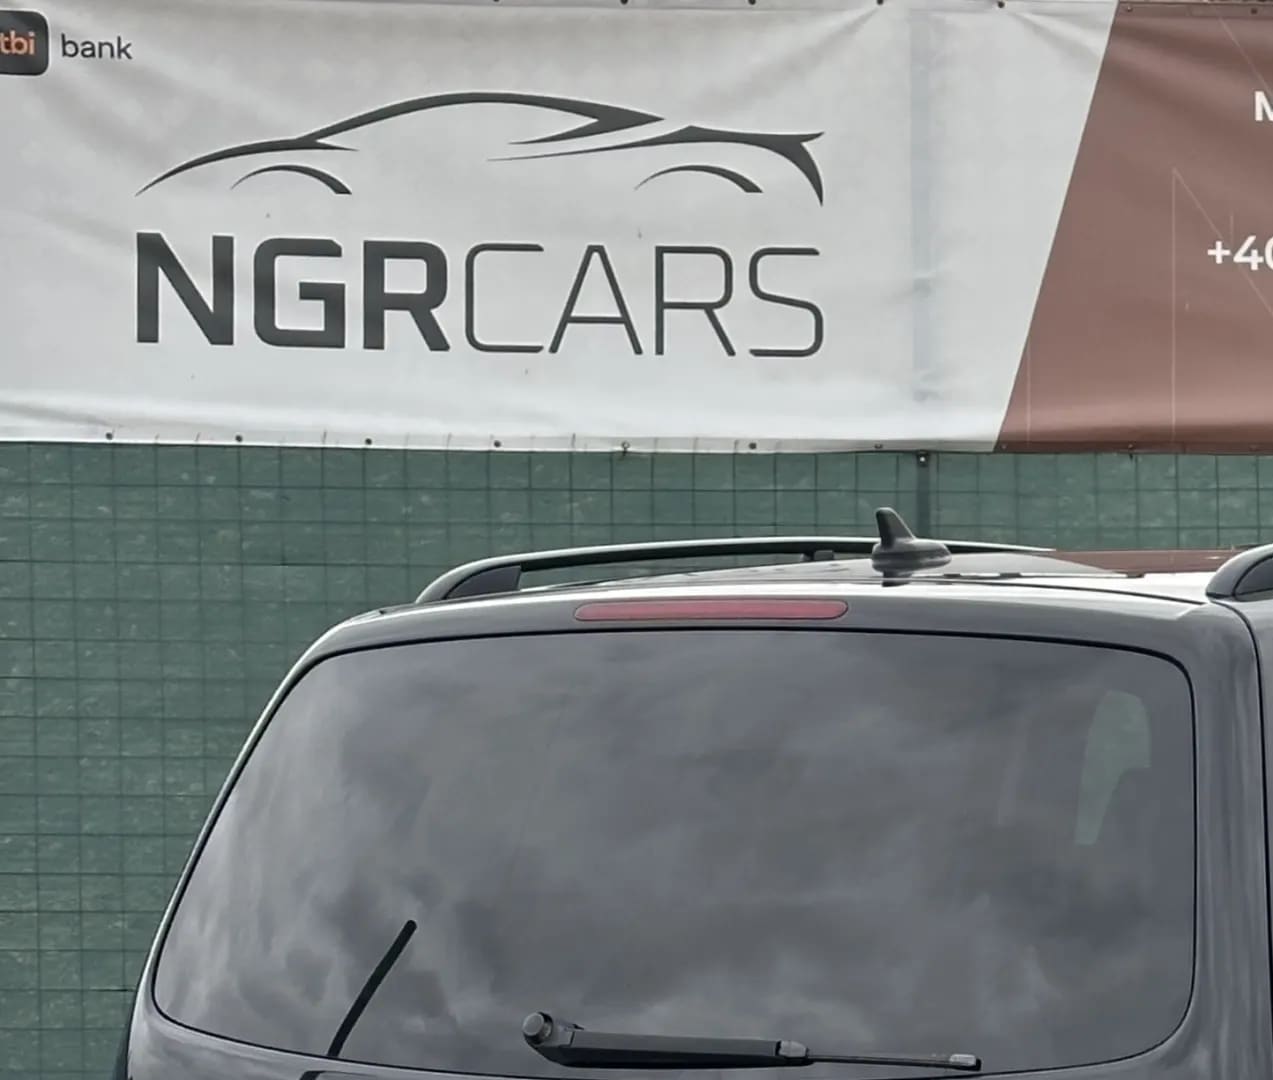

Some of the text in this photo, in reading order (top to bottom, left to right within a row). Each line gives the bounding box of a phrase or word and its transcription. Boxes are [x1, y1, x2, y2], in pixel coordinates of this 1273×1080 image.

[0, 30, 133, 60] tbi bank
[135, 231, 825, 359] NGRCARS
